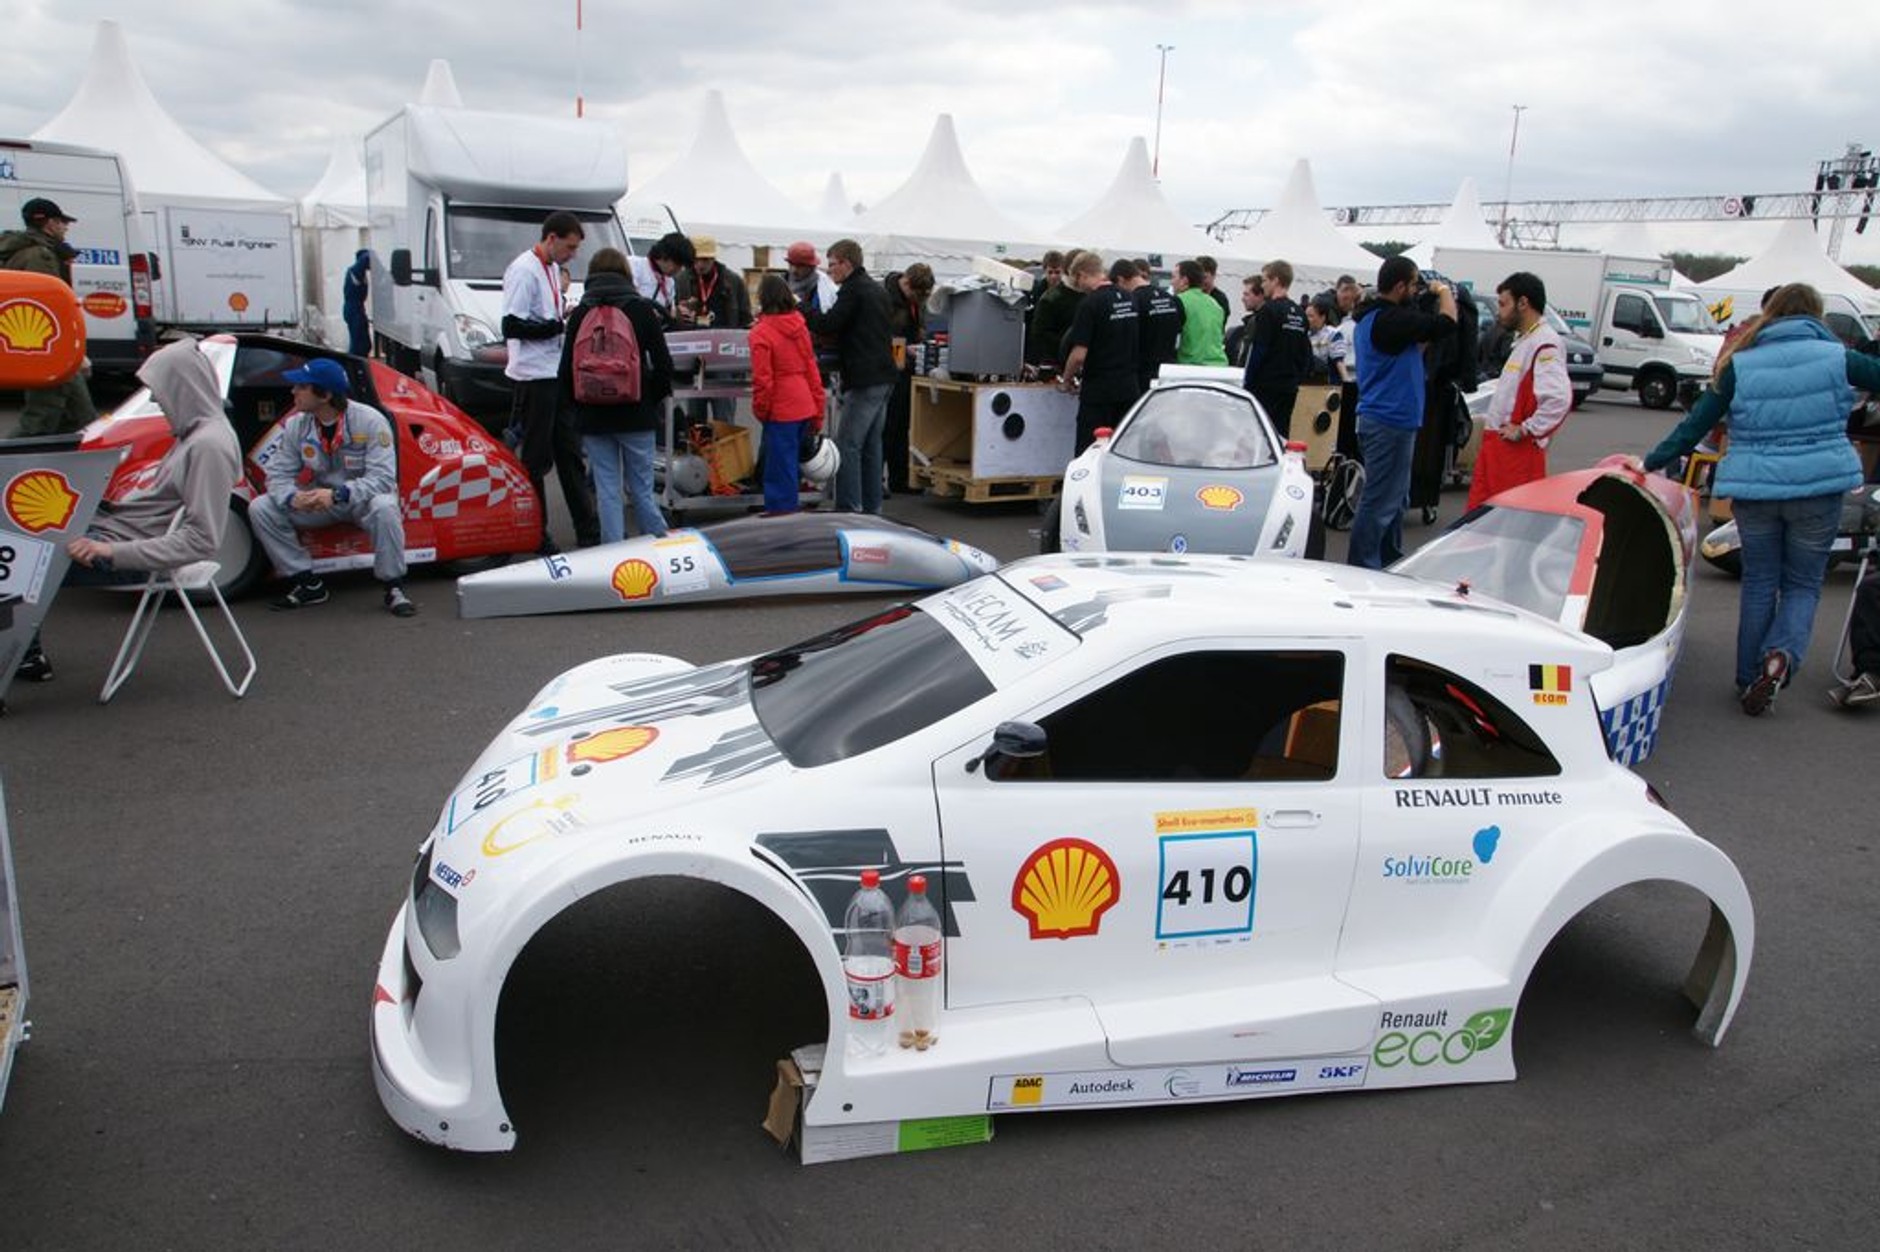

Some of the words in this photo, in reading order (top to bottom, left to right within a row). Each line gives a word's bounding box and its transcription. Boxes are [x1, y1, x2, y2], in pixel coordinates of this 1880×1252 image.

[1124, 486, 1162, 497] 403
[670, 556, 695, 574] 55
[1533, 693, 1568, 704] ecam
[1395, 788, 1492, 808] RENAULT
[1498, 790, 1562, 805] minute
[1157, 817, 1180, 828] Shell
[1383, 855, 1473, 878] SolviCore
[1162, 865, 1252, 906] 410
[1380, 1009, 1449, 1029] Renault
[1014, 1077, 1043, 1089] ADAC
[1069, 1079, 1135, 1095] Autodesk
[1239, 1070, 1296, 1083] MICHELIN
[1318, 1065, 1363, 1079] SKF
